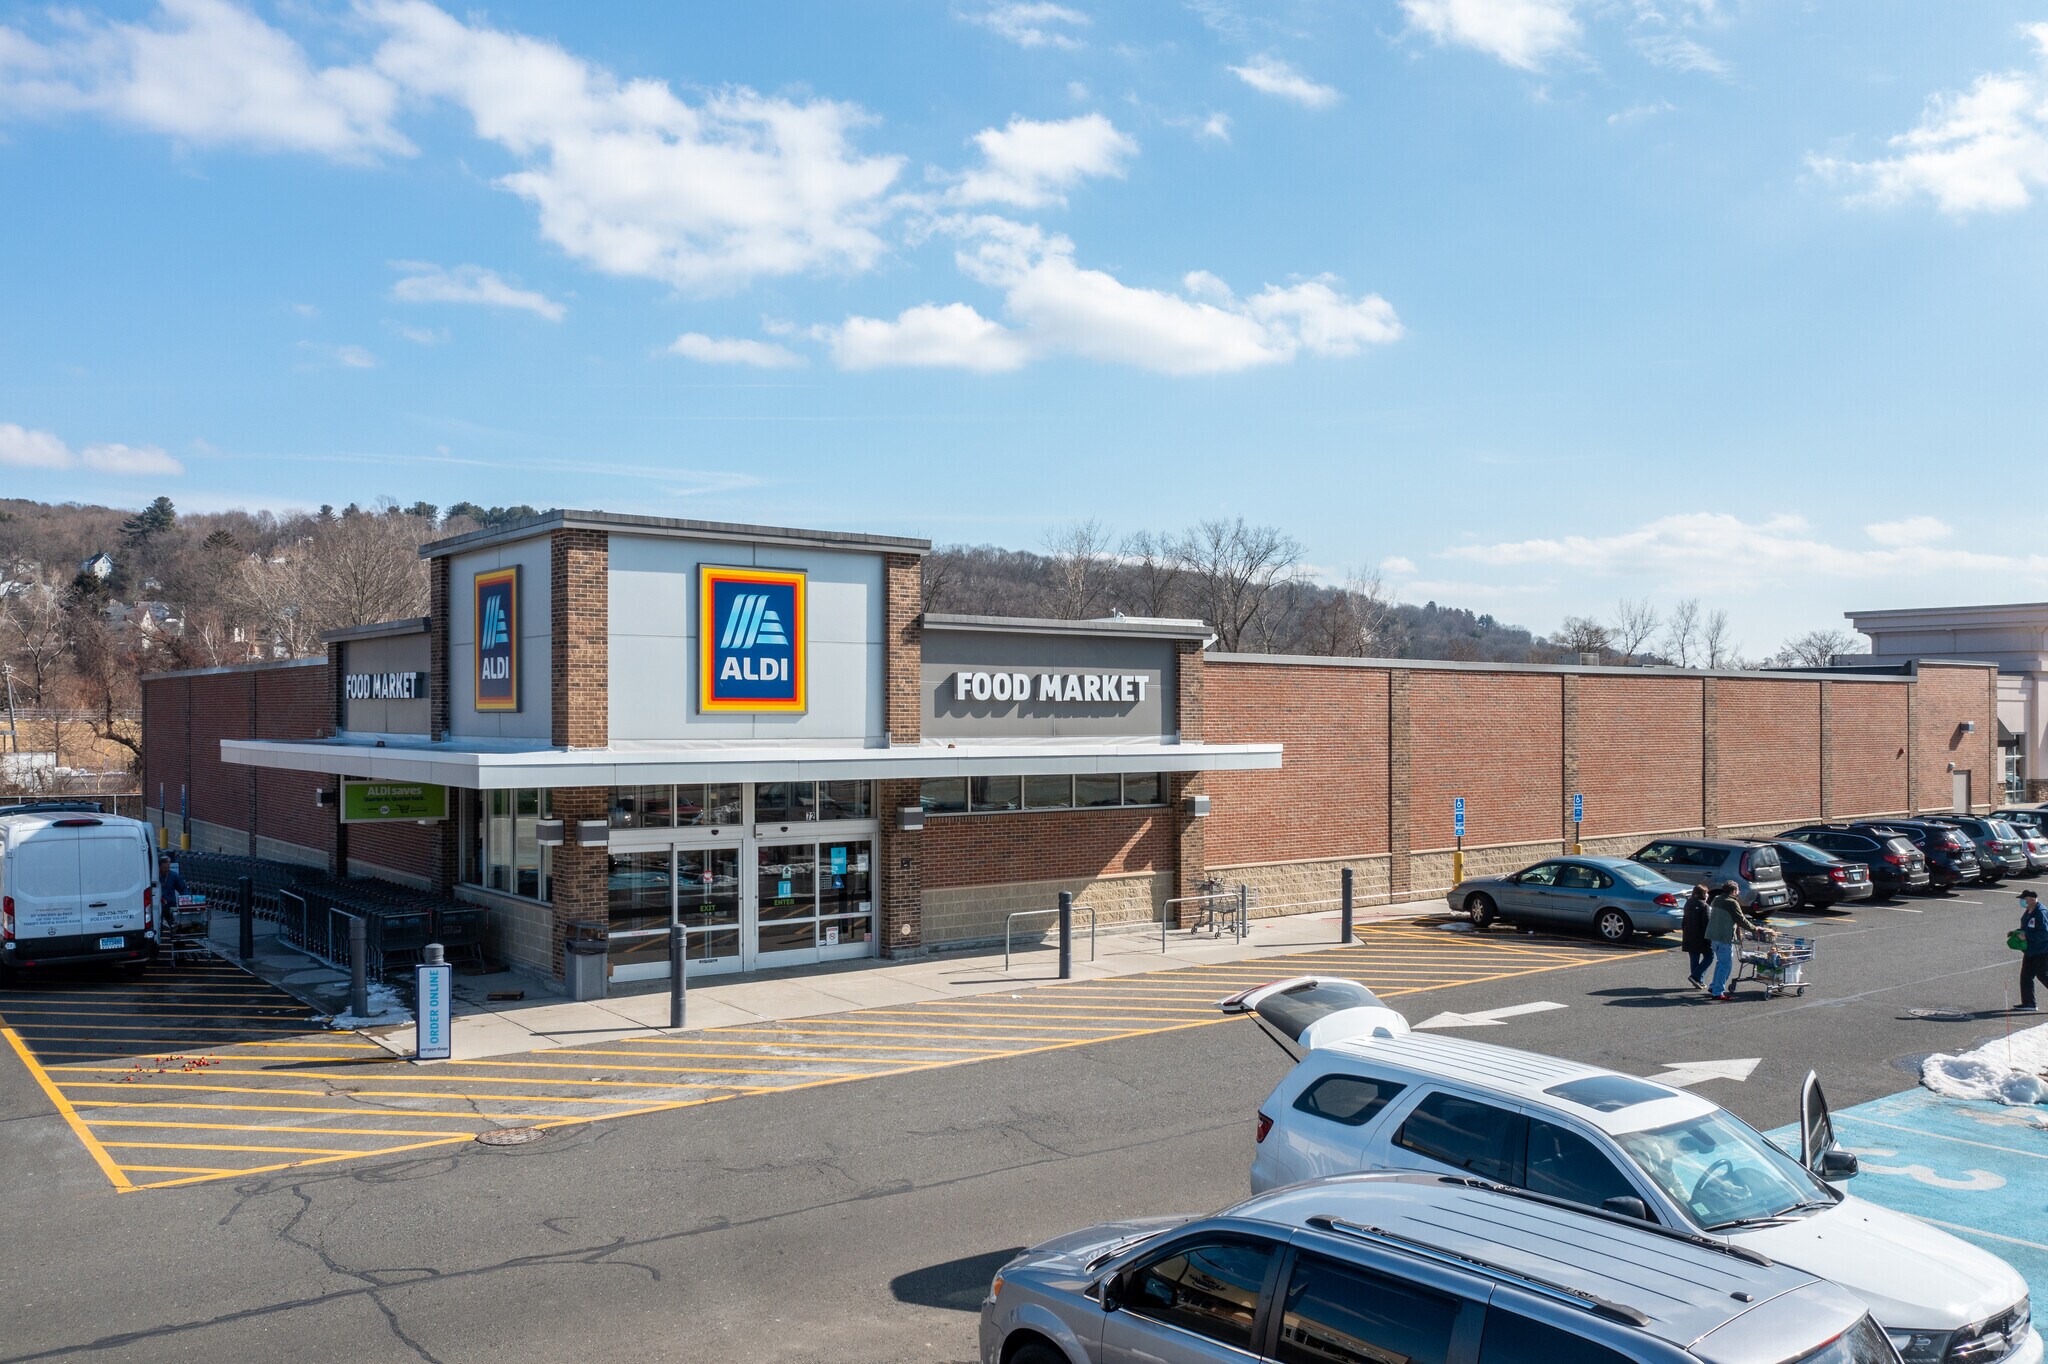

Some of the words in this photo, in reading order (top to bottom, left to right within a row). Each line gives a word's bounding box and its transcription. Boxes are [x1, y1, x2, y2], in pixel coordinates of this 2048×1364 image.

[482, 656, 510, 680] ALDI
[720, 656, 788, 682] ALDI
[346, 673, 370, 699] FOOD
[372, 671, 416, 699] MARKET
[956, 671, 1031, 702] FOOD
[1038, 673, 1150, 702] MARKET
[367, 786, 391, 796] ALDI
[392, 786, 423, 795] saves
[700, 904, 716, 912] EXIT
[774, 898, 795, 906] ENTER
[429, 969, 439, 1007] ONLINE
[429, 1010, 439, 1044] ORDER
